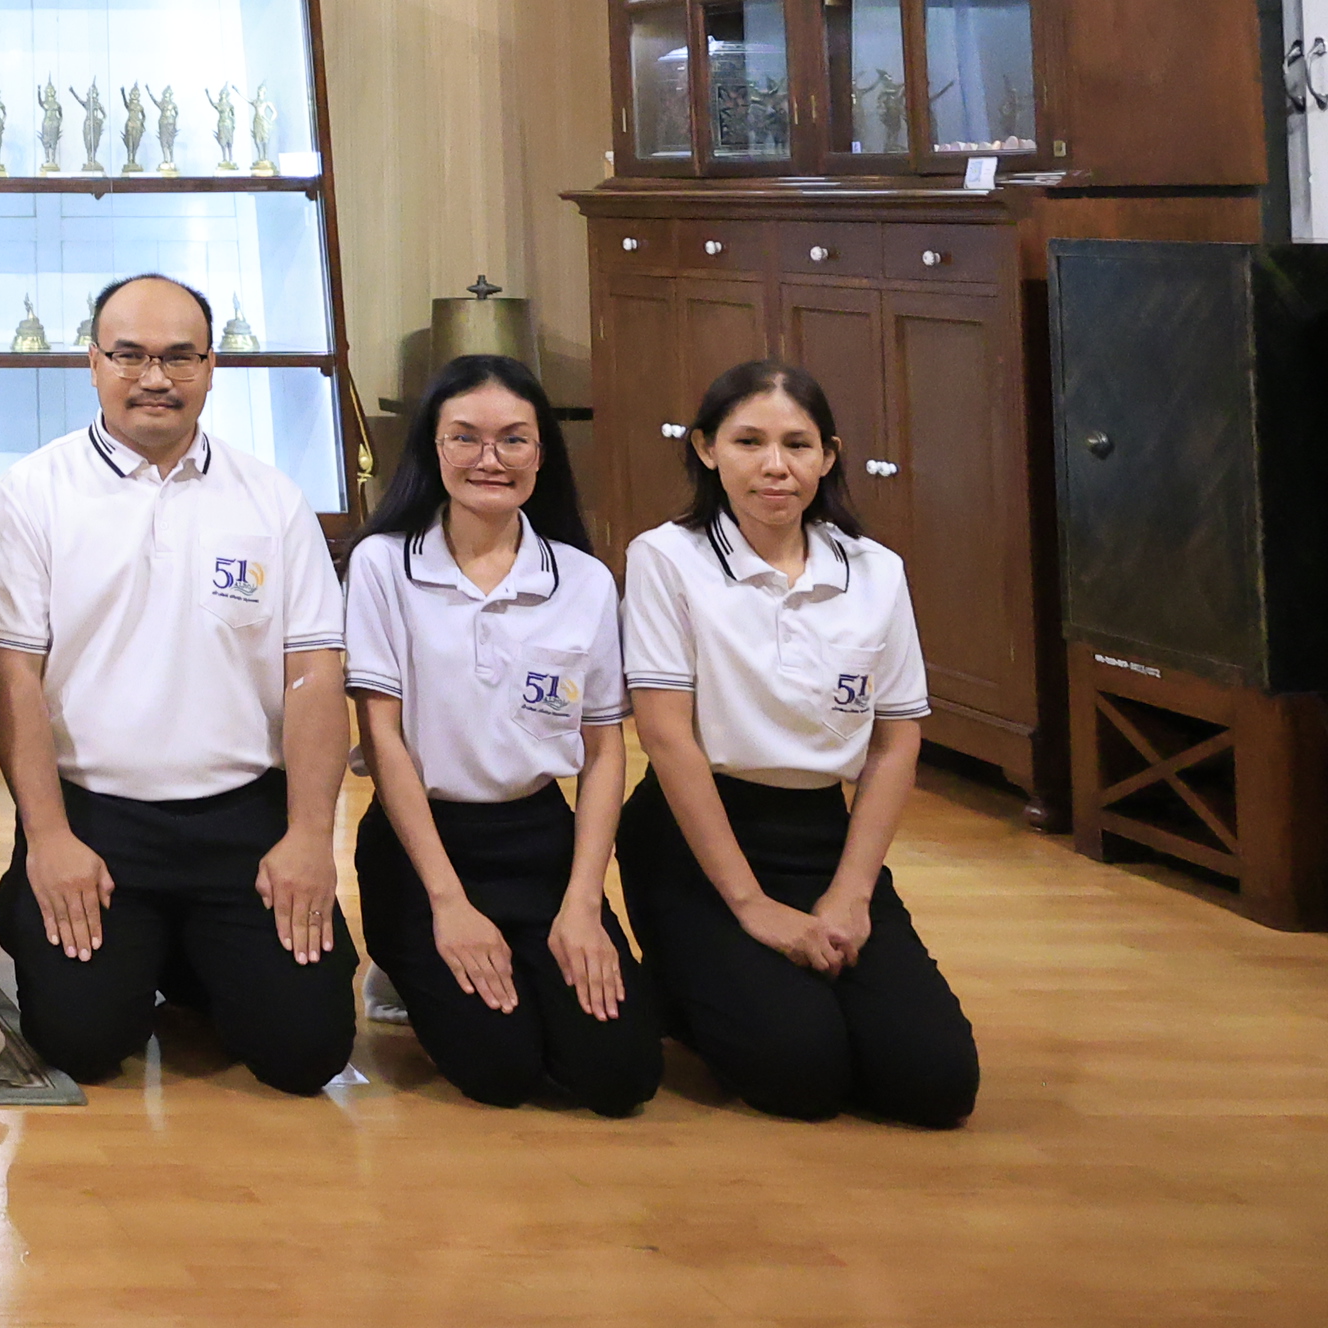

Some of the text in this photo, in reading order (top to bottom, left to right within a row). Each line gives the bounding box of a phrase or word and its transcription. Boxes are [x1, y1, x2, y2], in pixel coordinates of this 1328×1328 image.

[213, 557, 248, 589] 51
[523, 672, 559, 703] 51
[834, 674, 868, 705] 51
